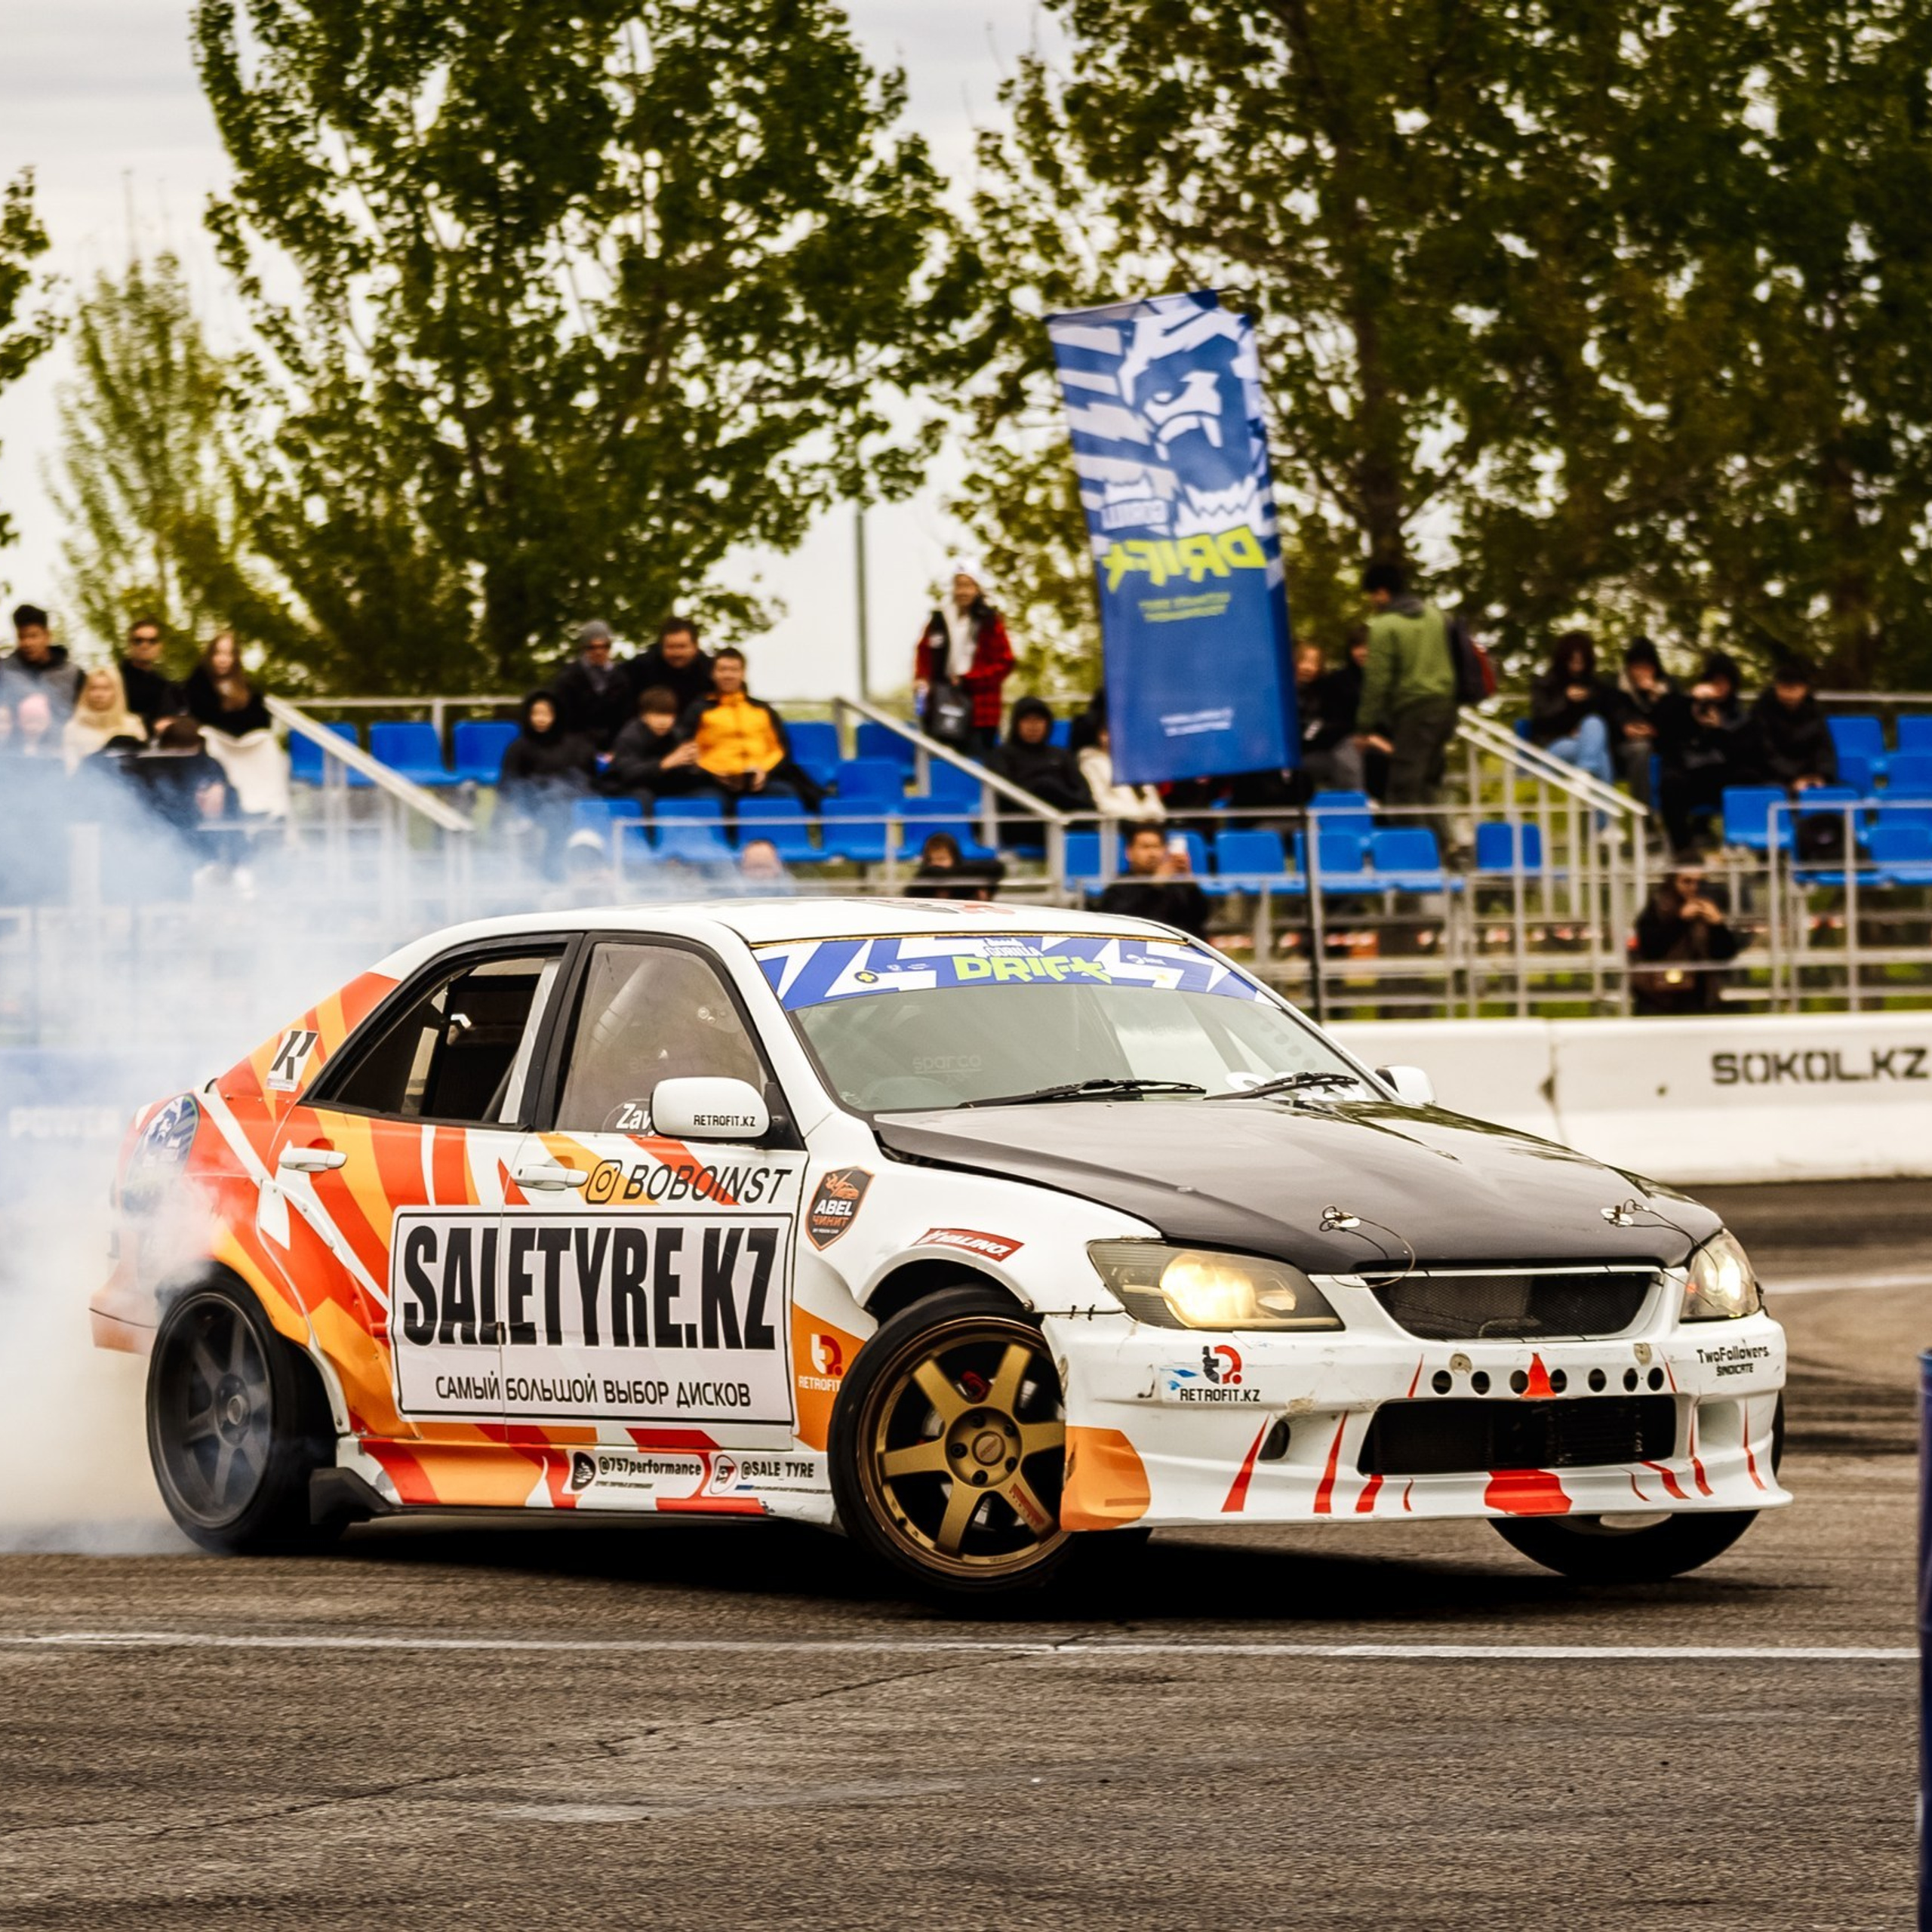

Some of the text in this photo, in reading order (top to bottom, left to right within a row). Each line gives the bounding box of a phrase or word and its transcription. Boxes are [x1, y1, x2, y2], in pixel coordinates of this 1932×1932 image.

[952, 955, 1112, 984] DRIFT
[1710, 1047, 1930, 1085] SOKOL.KZ
[694, 1115, 755, 1127] RETROFIT.KZ
[622, 1164, 793, 1204] BOBOINST
[814, 1198, 853, 1217] ABEL
[403, 1225, 780, 1351] SALETYRE.KZ
[1696, 1345, 1770, 1364] TwoFollowers
[435, 1371, 752, 1409] САМЫЙ БОЛЬШОЙ ВЫБОР ДИСКОВ
[1180, 1388, 1261, 1402] RETROFIT.KZ
[598, 1456, 703, 1476] @757performance
[785, 1462, 815, 1478] TYRE
